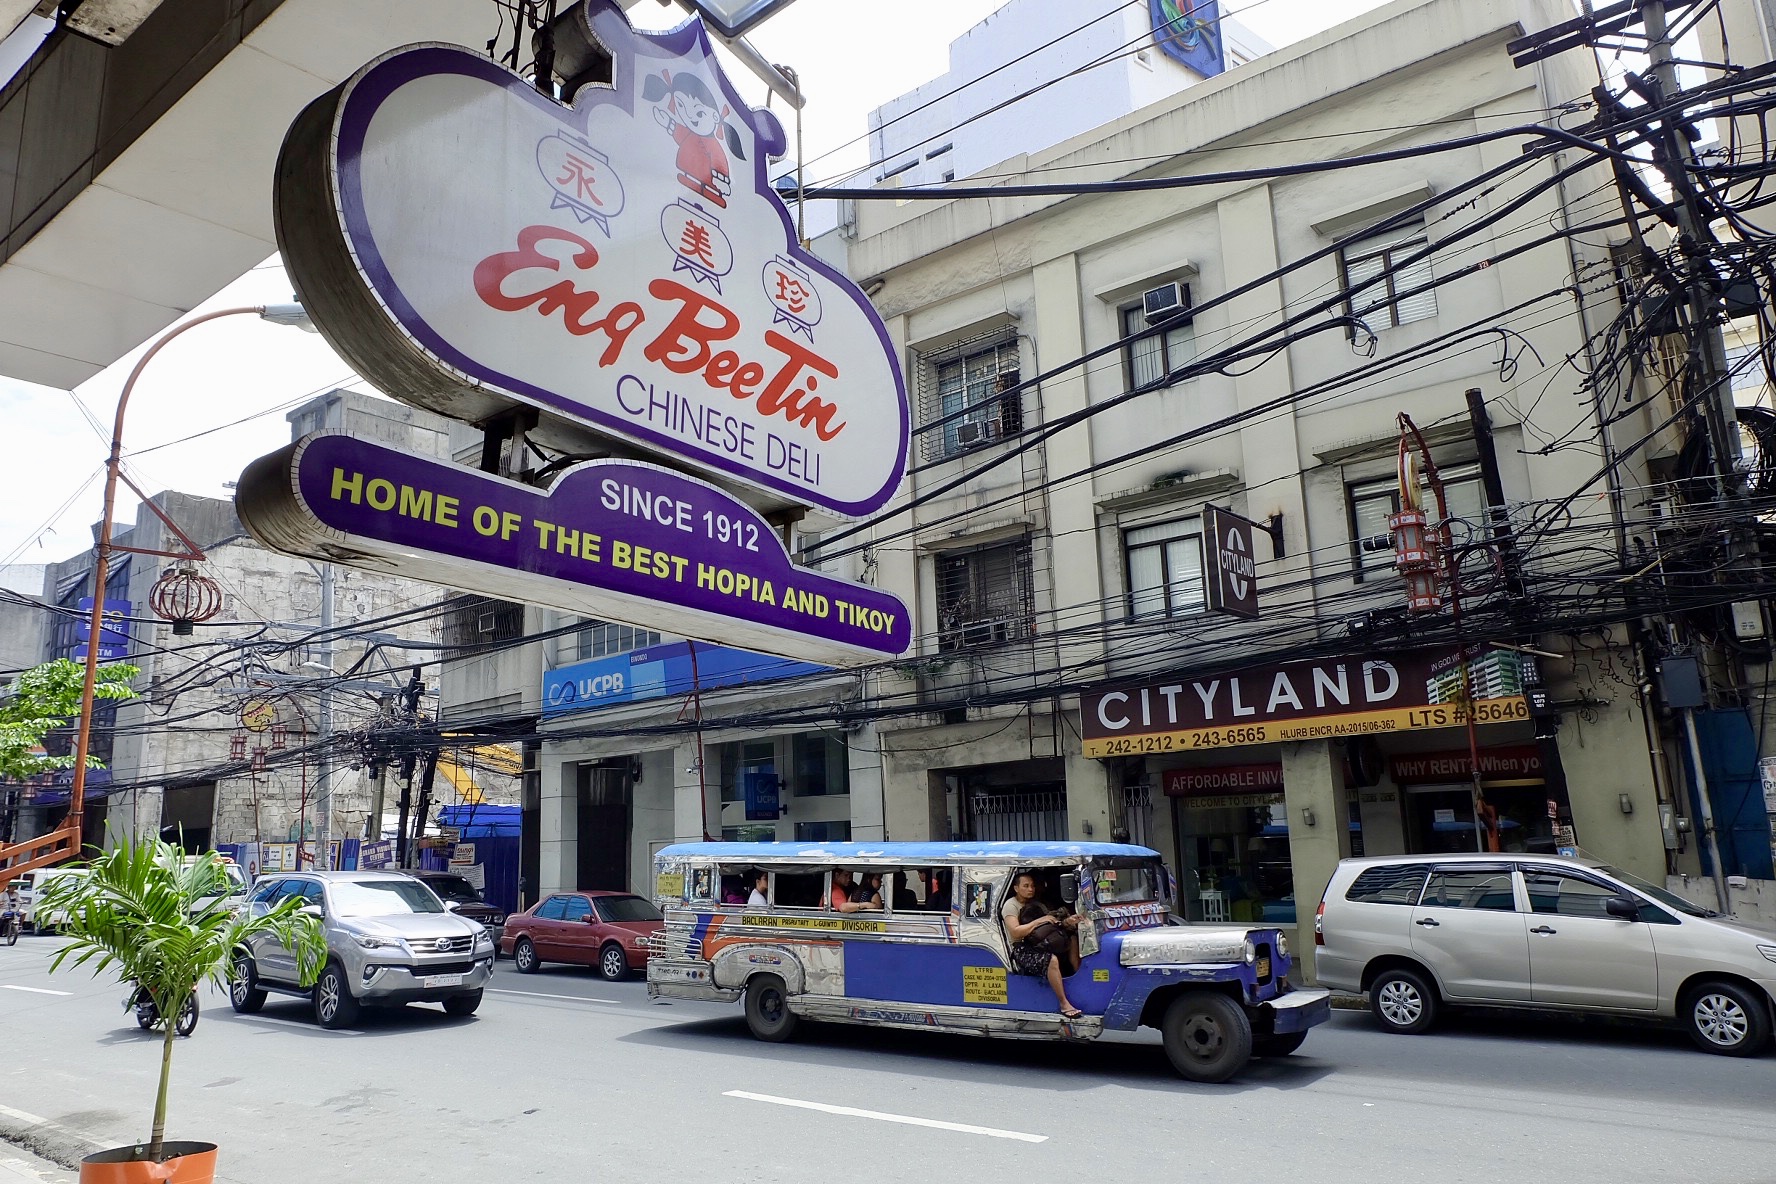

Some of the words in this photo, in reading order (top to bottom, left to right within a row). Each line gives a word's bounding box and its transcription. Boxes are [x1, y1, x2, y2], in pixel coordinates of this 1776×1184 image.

[555, 152, 604, 208] 永
[679, 218, 714, 272] 美
[774, 270, 811, 315] 珍
[472, 223, 646, 367] Eng
[643, 277, 764, 404] Bee
[756, 328, 847, 442] Tin
[615, 373, 756, 461] CHINESE
[766, 434, 821, 486] DELI
[600, 478, 694, 534] SINCE
[702, 509, 761, 552] 1912
[330, 466, 459, 529] HOME
[472, 504, 521, 542] OF
[533, 518, 601, 564] THE
[612, 538, 689, 585] BEST
[697, 563, 775, 609] HOPIA
[783, 586, 829, 619] AND
[834, 600, 895, 635] TIKOY
[1221, 549, 1254, 578] CITYLAND
[1438, 656, 1451, 668] GOD
[578, 672, 624, 699] UCPB
[1097, 660, 1400, 730] CITYLAND
[1105, 734, 1173, 755] 242-1212
[1192, 726, 1266, 748] 243-6565
[1280, 726, 1308, 740] HLURB
[1309, 724, 1333, 738] ENCR
[1333, 719, 1396, 736] AA-2015/06-362
[1409, 708, 1447, 727] LTS
[1171, 767, 1254, 790] AFFORDABLE
[1395, 760, 1426, 777] WHY
[1479, 755, 1514, 772] When
[1182, 798, 1227, 809] WELCOME
[1229, 797, 1241, 806] TO
[742, 915, 778, 927] BACLARAN
[841, 920, 878, 932] DIVISORIA
